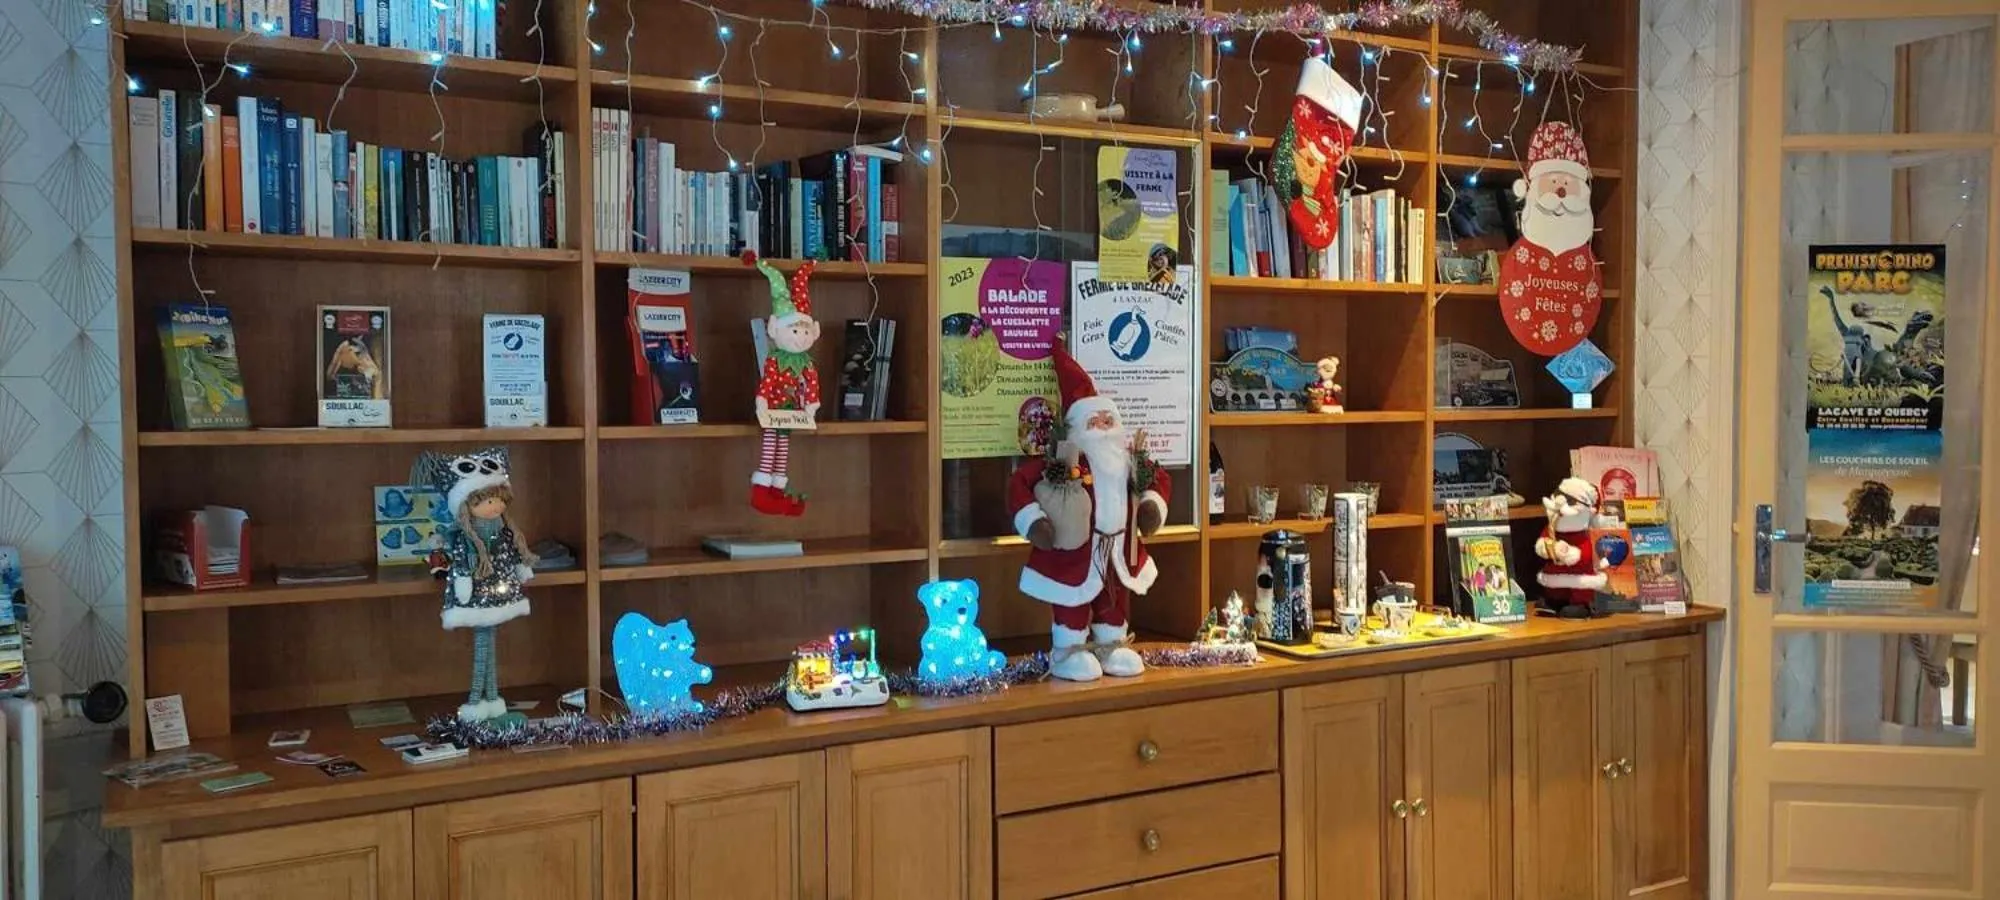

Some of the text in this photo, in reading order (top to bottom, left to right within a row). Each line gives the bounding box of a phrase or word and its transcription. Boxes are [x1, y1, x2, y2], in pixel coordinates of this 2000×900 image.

[1125, 171, 1155, 179] VISITE
[1136, 183, 1163, 193] FERME
[948, 267, 975, 287] 2023
[1524, 273, 1578, 292] Joyeuses
[1836, 271, 1912, 295] PARC
[988, 289, 1047, 304] BALADE
[1535, 296, 1568, 313] Fêtes
[1049, 307, 1060, 315] DE
[991, 317, 1050, 326] LA CUEILLETTE
[1083, 318, 1104, 330] Foie
[1003, 329, 1039, 338] SAUVAGE
[1155, 319, 1186, 337] Confits
[1082, 332, 1104, 345] Gras
[326, 401, 364, 409] SOUILLAC
[489, 398, 525, 406] SOUILLAC
[1818, 407, 1929, 417] LACAVE EN QUERCY
[1820, 456, 1929, 465] LES COUCHERS DE SOLEIL
[1493, 599, 1510, 615] 30
